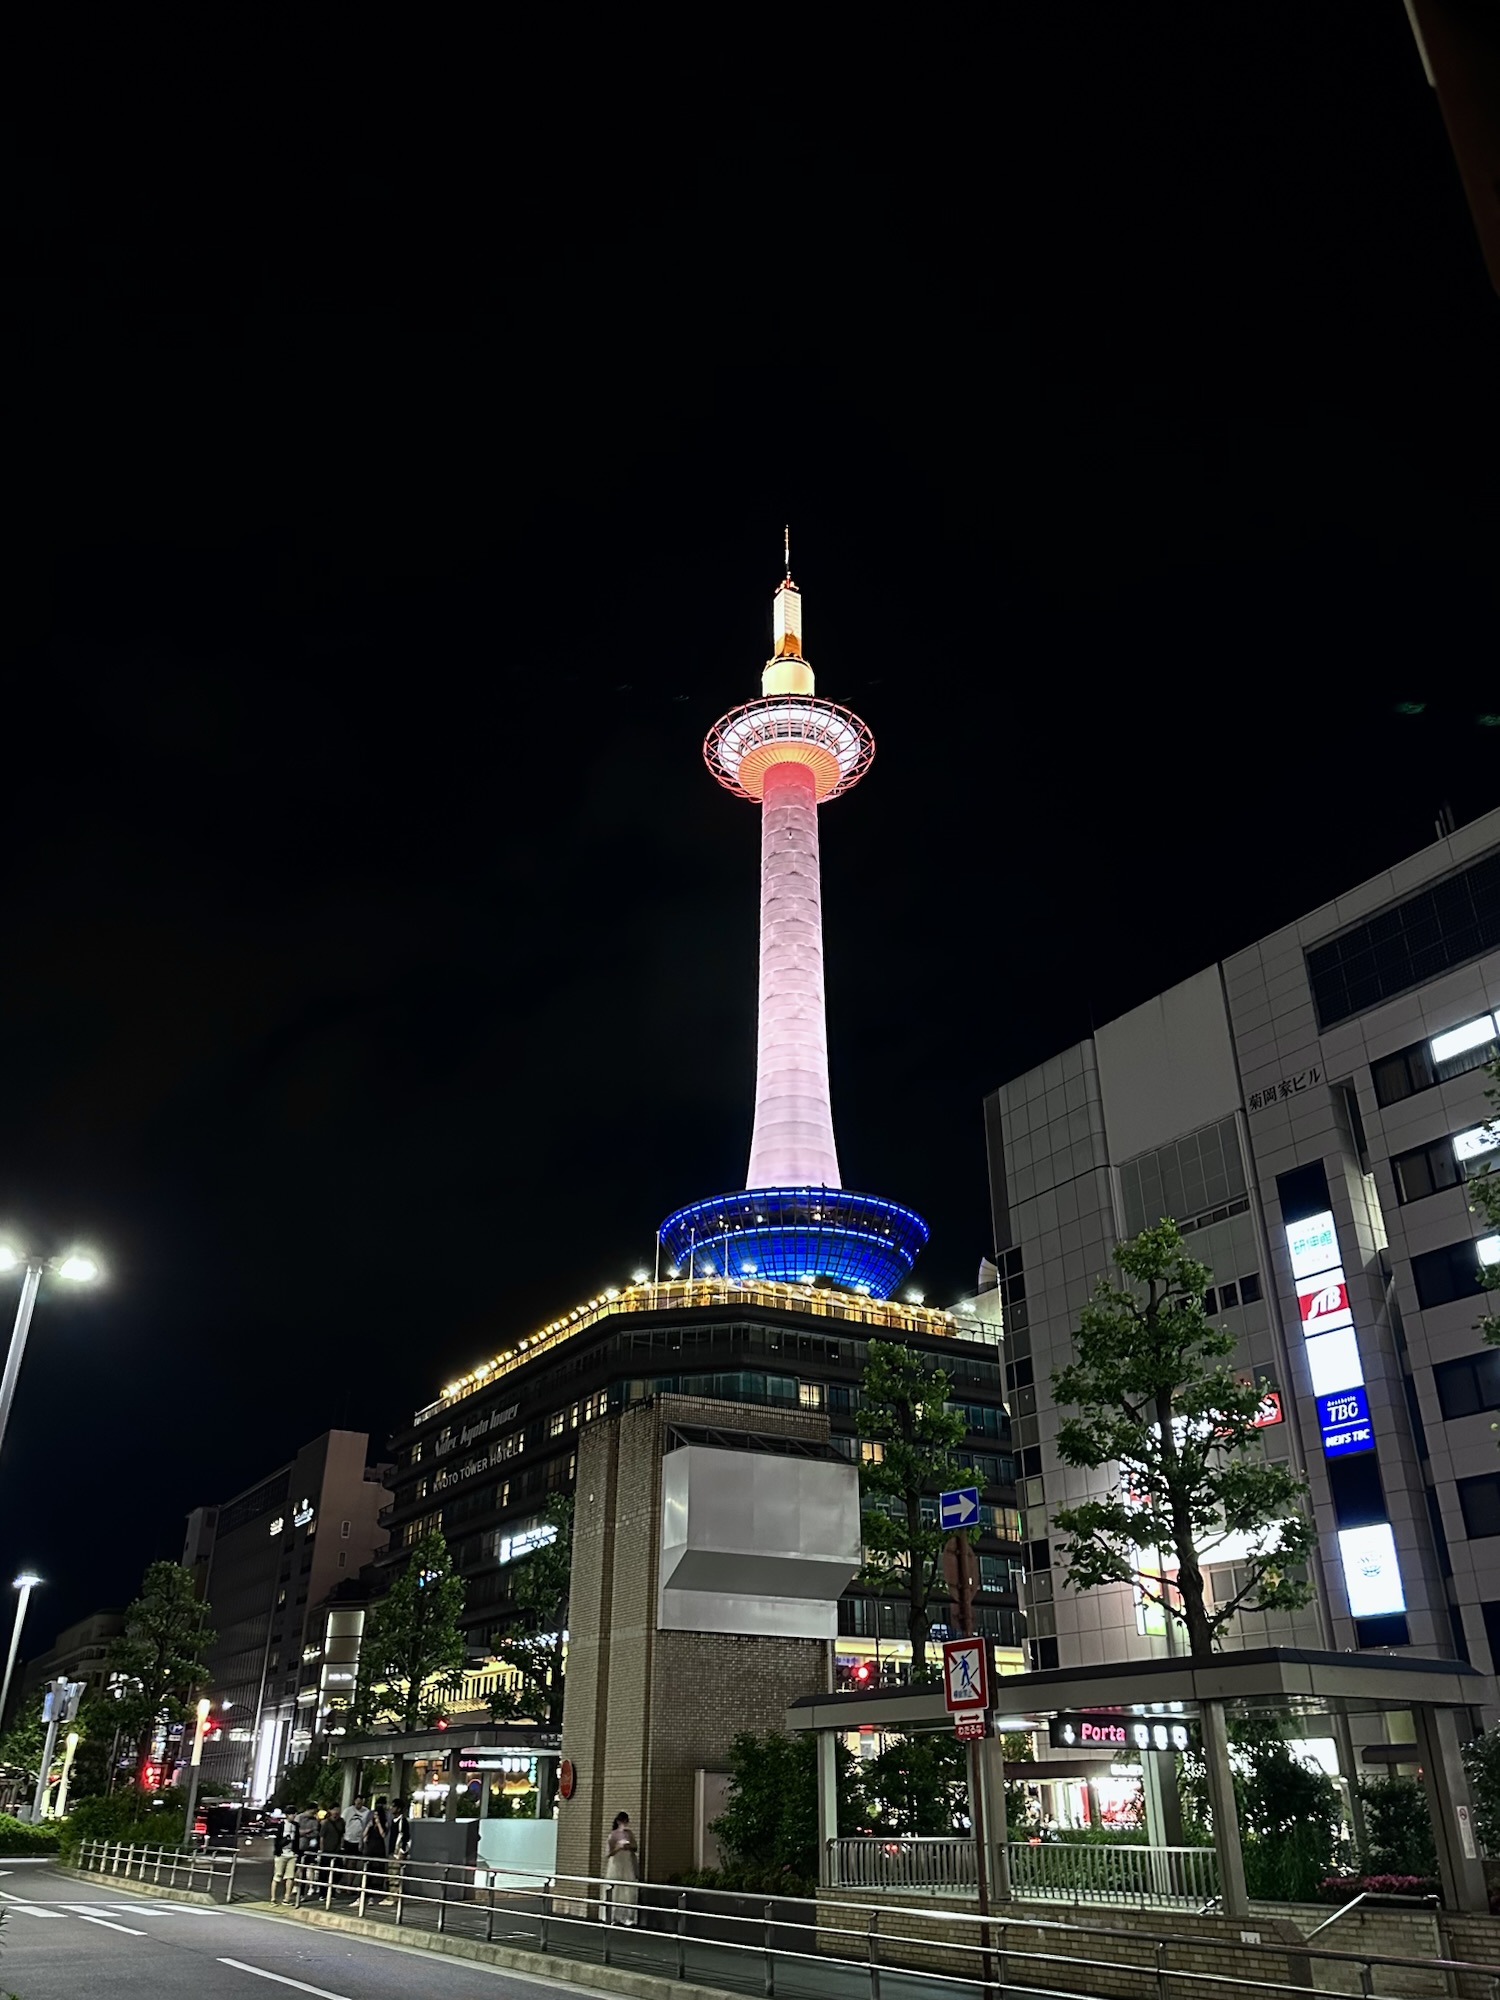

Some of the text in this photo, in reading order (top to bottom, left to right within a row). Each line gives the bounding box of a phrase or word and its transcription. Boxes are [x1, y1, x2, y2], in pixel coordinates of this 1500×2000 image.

[1249, 1068, 1321, 1111] 菊岡家ビル
[1307, 1286, 1342, 1320] JTB
[1326, 1402, 1359, 1422] TBC
[1352, 1428, 1370, 1442] TBC
[433, 1442, 518, 1493] KYOTO TOWER HOTEL
[958, 1725, 983, 1736] わたるな
[1081, 1722, 1126, 1742] Porta
